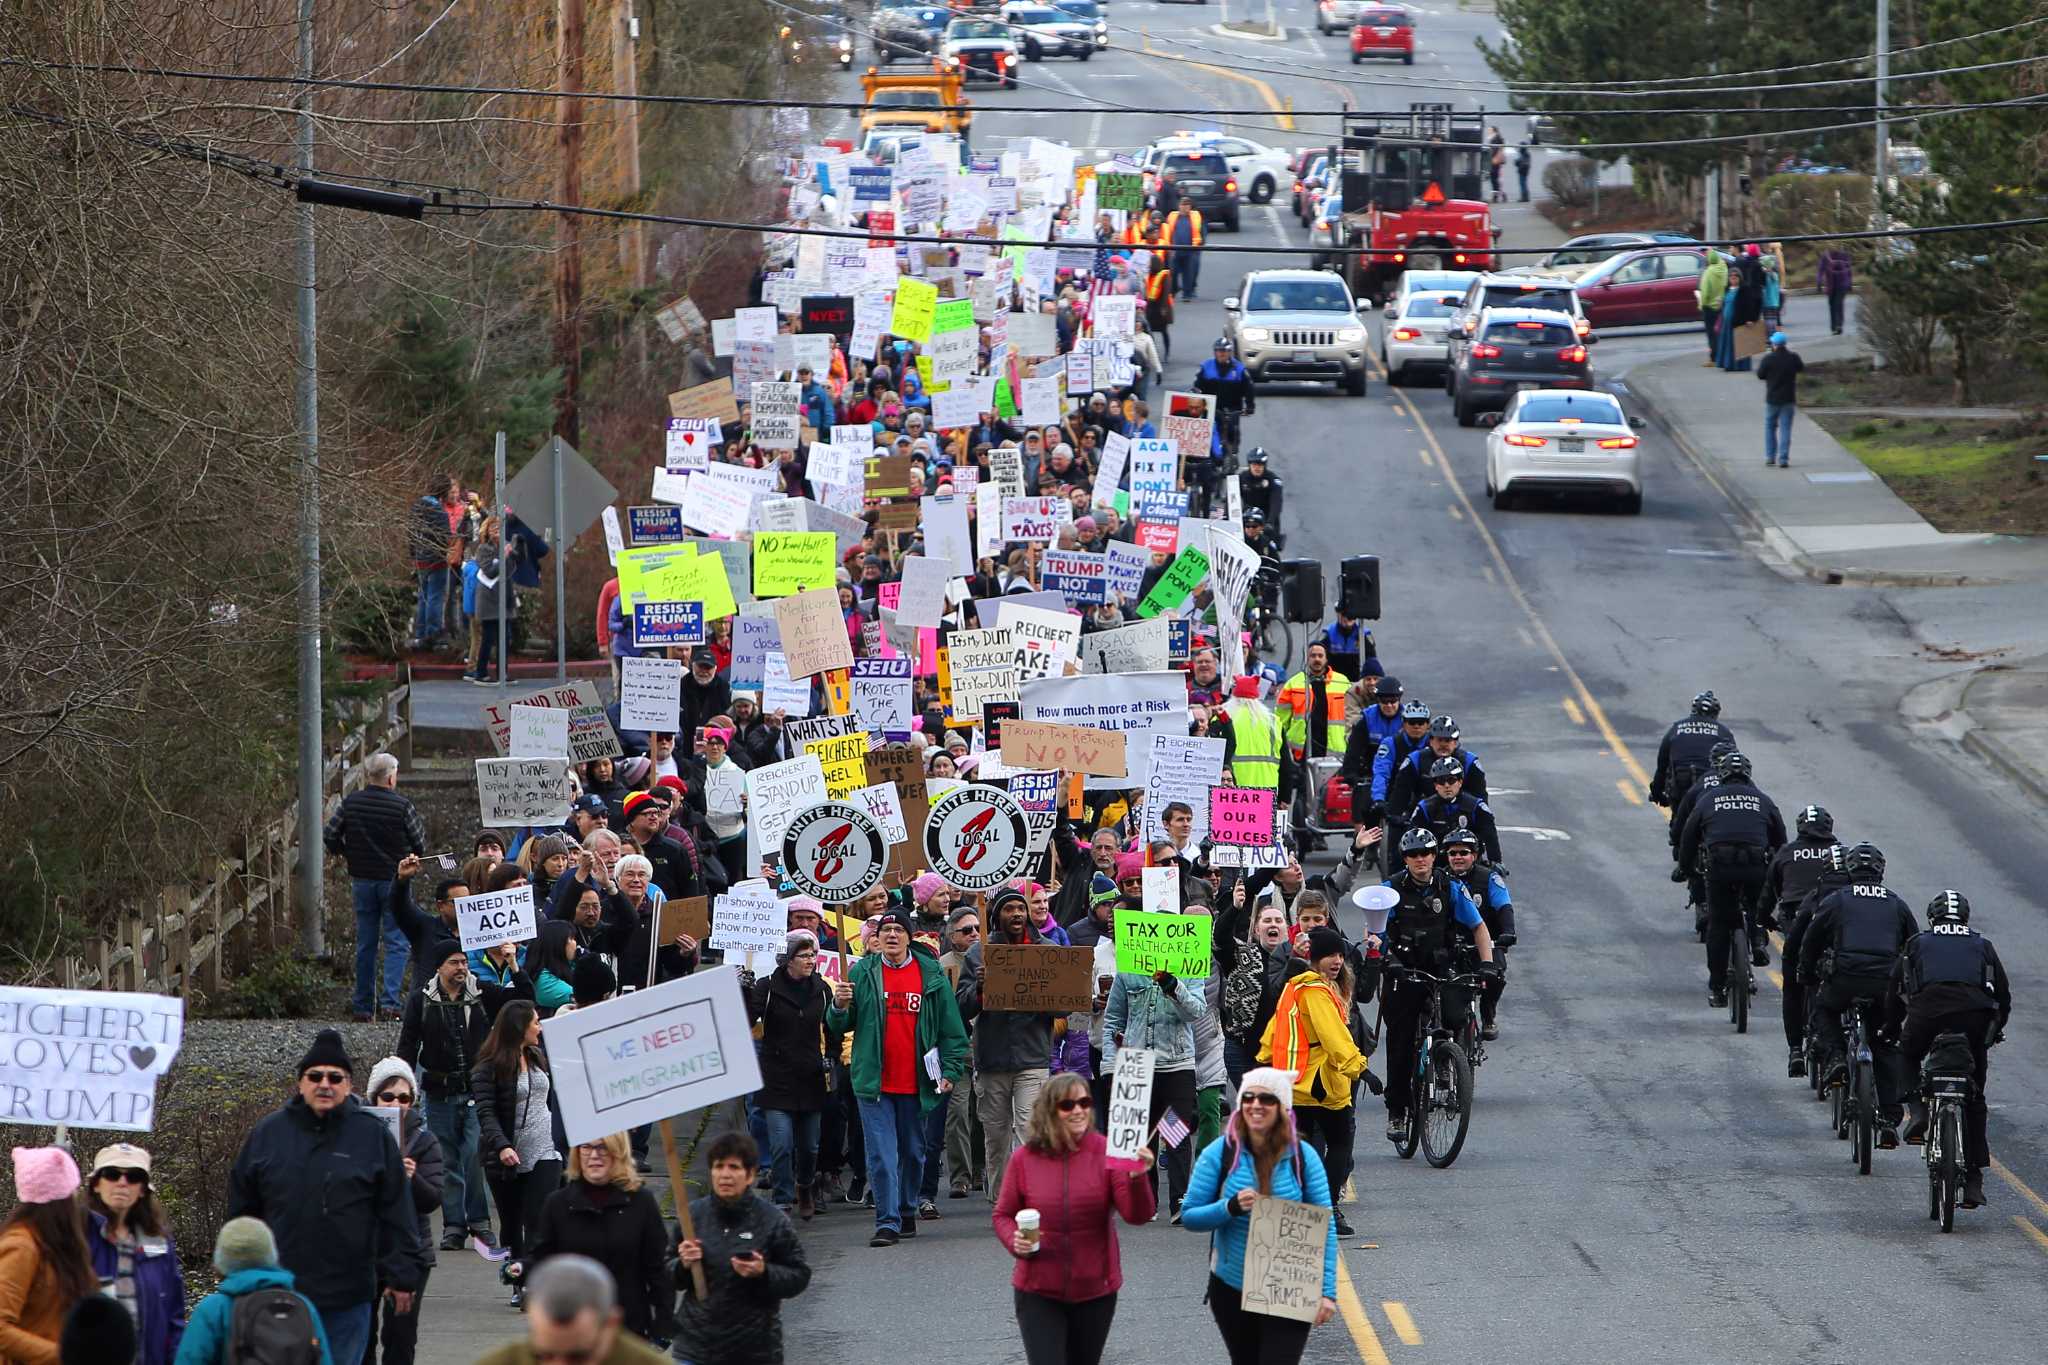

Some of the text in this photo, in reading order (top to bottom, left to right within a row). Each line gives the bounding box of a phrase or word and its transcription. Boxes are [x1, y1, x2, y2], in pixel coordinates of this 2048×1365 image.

[808, 310, 847, 321] NYET
[760, 383, 790, 392] STOP
[670, 418, 703, 430] SEIU
[1139, 442, 1168, 452] ACA
[1134, 462, 1154, 472] FIX
[1145, 490, 1188, 507] HATE
[636, 508, 673, 518] RESIST
[634, 517, 679, 527] TRUMP
[759, 537, 779, 553] NO
[1109, 550, 1145, 567] RELEASE
[1047, 560, 1104, 577] TRUMP
[1058, 576, 1090, 591] NOT
[1166, 572, 1193, 594] PONY
[644, 603, 693, 615] RESIST
[639, 614, 699, 625] TRUMP
[638, 632, 701, 642] AMERICA GREAT!
[984, 629, 1012, 646] DUTY
[1015, 620, 1073, 644] REICHERT
[753, 638, 782, 650] close
[855, 660, 908, 676] SEIU
[989, 670, 1016, 689] DUTY
[854, 681, 909, 697] PROTECT
[486, 688, 583, 725] I FOR
[867, 697, 893, 708] THE
[1036, 700, 1171, 718] How much more at Risk
[787, 719, 841, 741] WHAT'S
[1099, 719, 1123, 731] ALL
[1677, 727, 1719, 736] POLICE
[1678, 721, 1719, 730] BELLEVUE
[569, 732, 588, 743] NOT
[572, 739, 618, 760] PRESIDENT
[1025, 743, 1100, 766] NOW
[864, 750, 914, 767] WHERE
[487, 763, 550, 776] HEY DAVE
[756, 761, 807, 785] REICHERT
[538, 779, 562, 790] WHY
[1012, 774, 1056, 790] RESIST
[862, 788, 886, 807] WE
[1219, 792, 1261, 804] HEAR
[1714, 794, 1761, 803] BELLEVUE
[929, 789, 1019, 829] UNITE HERE!
[1714, 801, 1761, 812] POLICE
[759, 808, 792, 831] GET
[786, 806, 876, 842] UNITE HERE!
[1223, 811, 1257, 824] OUR
[954, 828, 1001, 848] LOCAL
[1212, 829, 1269, 844] VOICES
[811, 843, 857, 861] LOCAL
[1250, 842, 1288, 867] ACA
[934, 846, 1026, 888] WASHINGTON
[791, 861, 882, 901] WASHINGTON
[1853, 884, 1888, 899] POLICE
[459, 891, 530, 914] I NEED THE
[730, 897, 755, 908] show
[756, 900, 775, 911] you
[479, 909, 521, 932] ACA
[716, 911, 771, 922] mine if you
[714, 922, 785, 937] show me yours
[1126, 922, 1198, 938] TAX OUR
[1933, 923, 1970, 936] POLICE
[465, 937, 473, 945] IT
[711, 938, 788, 953] Healthcare Plan
[990, 948, 1081, 967] GET YOUR
[1018, 967, 1057, 981] HANDS
[1180, 957, 1208, 977] NO!
[1014, 980, 1049, 994] OFF
[910, 995, 920, 1011] 8
[606, 1021, 696, 1061] WE NEED
[1124, 1050, 1145, 1065] WE
[603, 1050, 721, 1099] IMMIGRANTS
[1118, 1064, 1146, 1079] ARE
[1116, 1081, 1148, 1102] NOT
[1112, 1128, 1142, 1154] UP!
[1279, 1216, 1313, 1242] BEST
[1272, 1249, 1319, 1270] ACTOR
[1265, 1283, 1304, 1309] TRUMP
